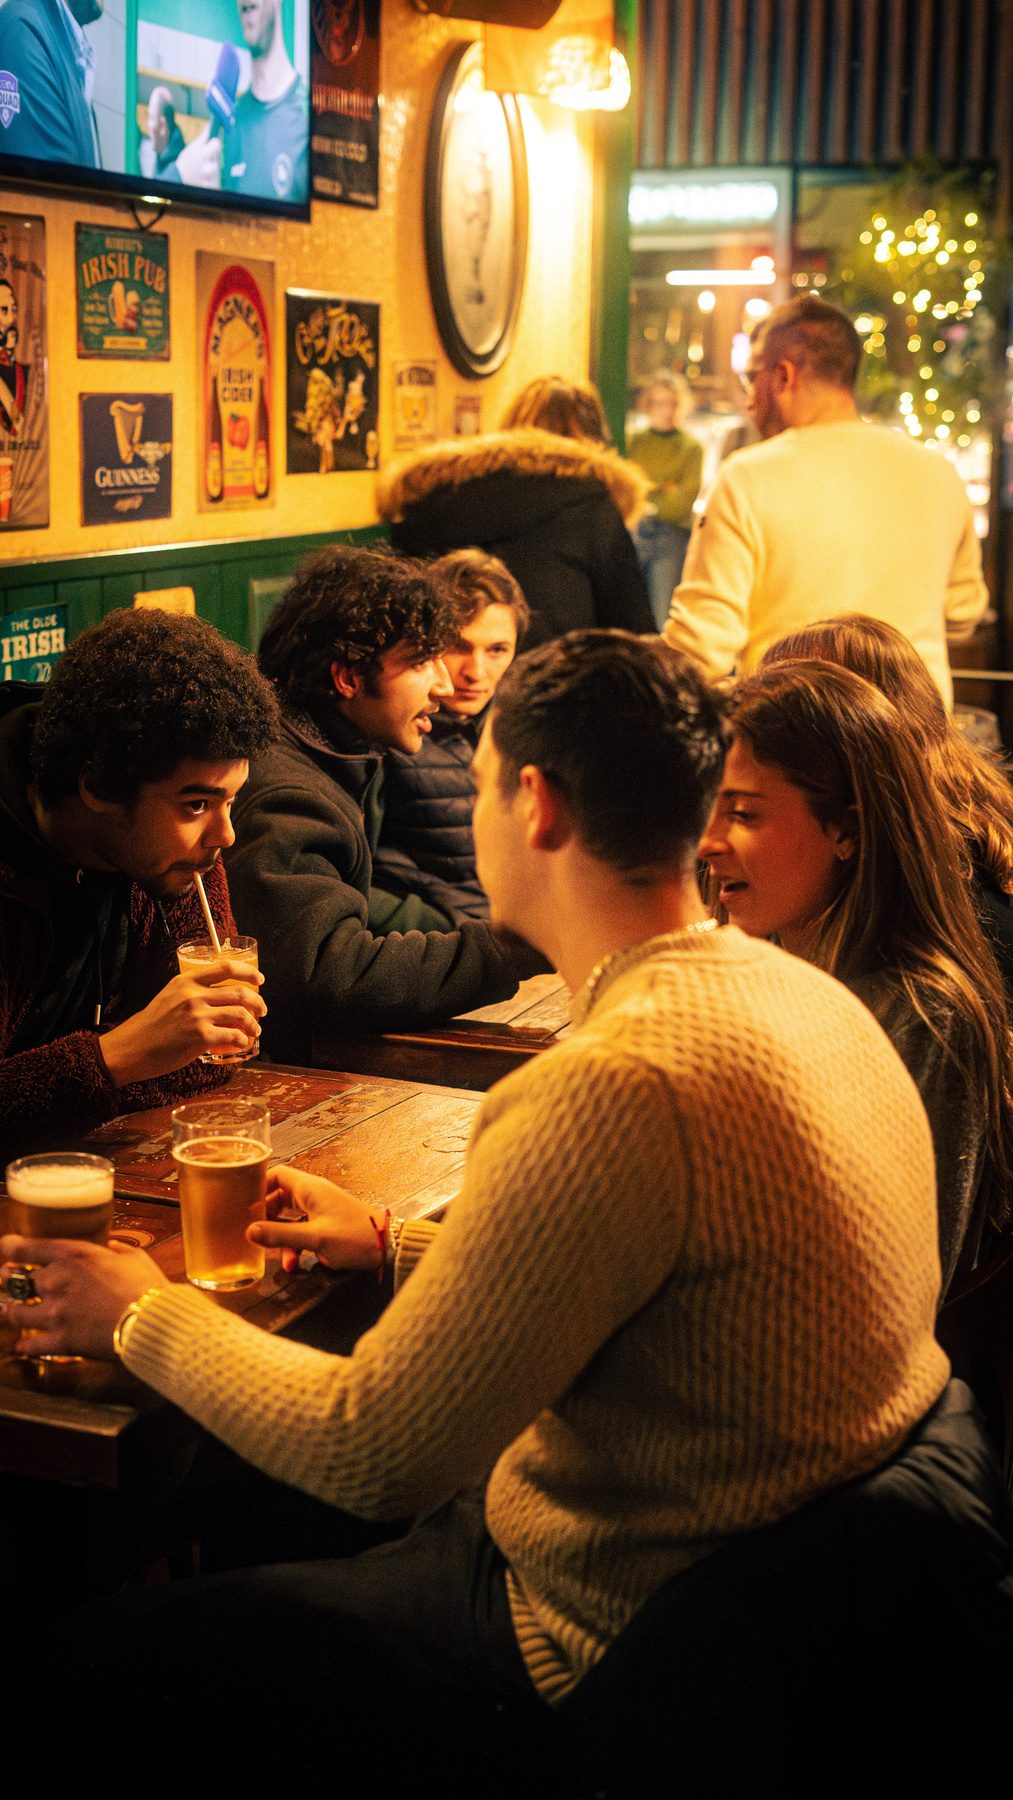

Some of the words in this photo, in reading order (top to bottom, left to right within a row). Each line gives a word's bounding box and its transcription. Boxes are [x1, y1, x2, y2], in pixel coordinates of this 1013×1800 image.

[82, 252, 130, 289] IRISH
[134, 255, 166, 293] PUB
[222, 368, 253, 383] IRISH
[222, 386, 252, 402] CIDER
[95, 466, 160, 488] GUINNESS
[11, 619, 30, 632] THE
[32, 614, 57, 629] OLDE
[1, 628, 65, 663] IRISH
